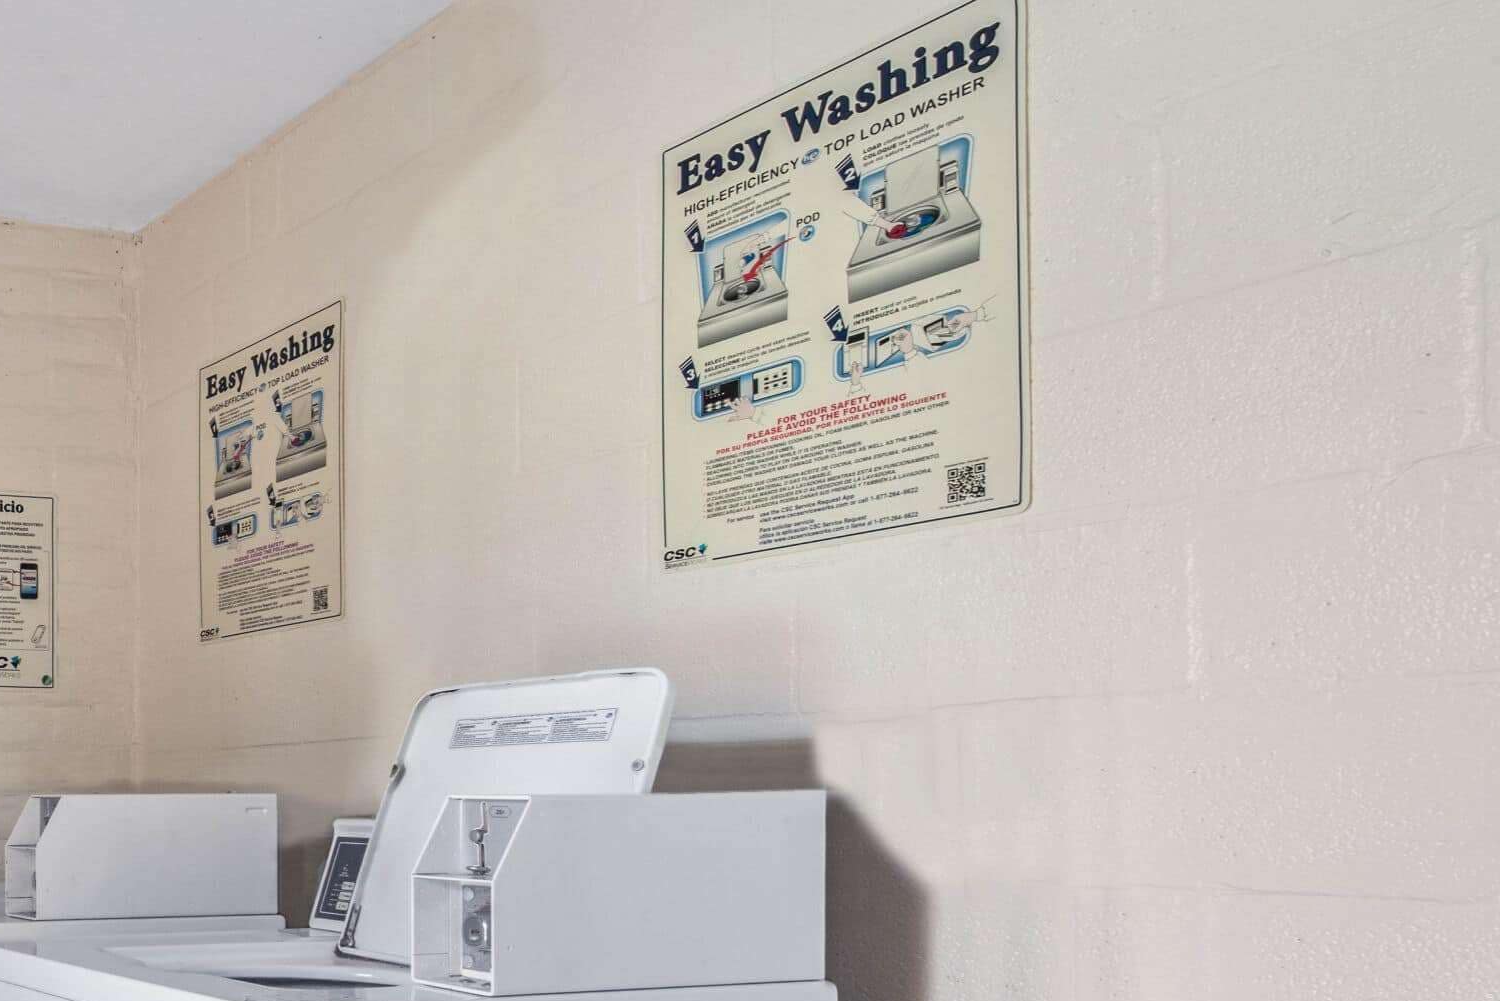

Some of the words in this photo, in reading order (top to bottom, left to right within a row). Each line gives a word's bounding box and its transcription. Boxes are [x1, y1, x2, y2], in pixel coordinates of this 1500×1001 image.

[676, 129, 771, 196] Easy
[780, 21, 1001, 143] Washing
[684, 157, 799, 218] HIGH-EFFICIENCY
[823, 133, 856, 156] TOP
[859, 111, 906, 141] LOAD
[909, 76, 986, 118] WASHER
[844, 167, 856, 183] 2
[796, 211, 821, 228] POD
[691, 233, 699, 245] 1
[853, 306, 878, 319] INSERT
[853, 306, 899, 326] INTRODUZCA
[832, 319, 844, 332] 4
[205, 365, 247, 400] Easy
[250, 324, 336, 380] Washing
[280, 368, 300, 385] LOAD
[300, 355, 330, 376] WASHER
[686, 368, 695, 381] 3
[746, 424, 783, 441] PLEASE
[785, 415, 816, 431] AVOID
[819, 409, 840, 422] THE
[843, 391, 907, 416] FOLLOWING
[777, 413, 796, 425] FOR
[800, 405, 827, 419] YOUR
[830, 393, 871, 411] SAFETY
[716, 446, 730, 456] POR
[731, 443, 740, 452] SU
[742, 436, 768, 449] PROPIA
[816, 420, 831, 431] POR
[833, 413, 859, 426] FAVOR
[861, 406, 885, 419] EVITE
[886, 403, 898, 413] LO
[900, 391, 947, 409] SIGUIENTE
[663, 546, 697, 561] CSC
[200, 629, 216, 638] CSC
